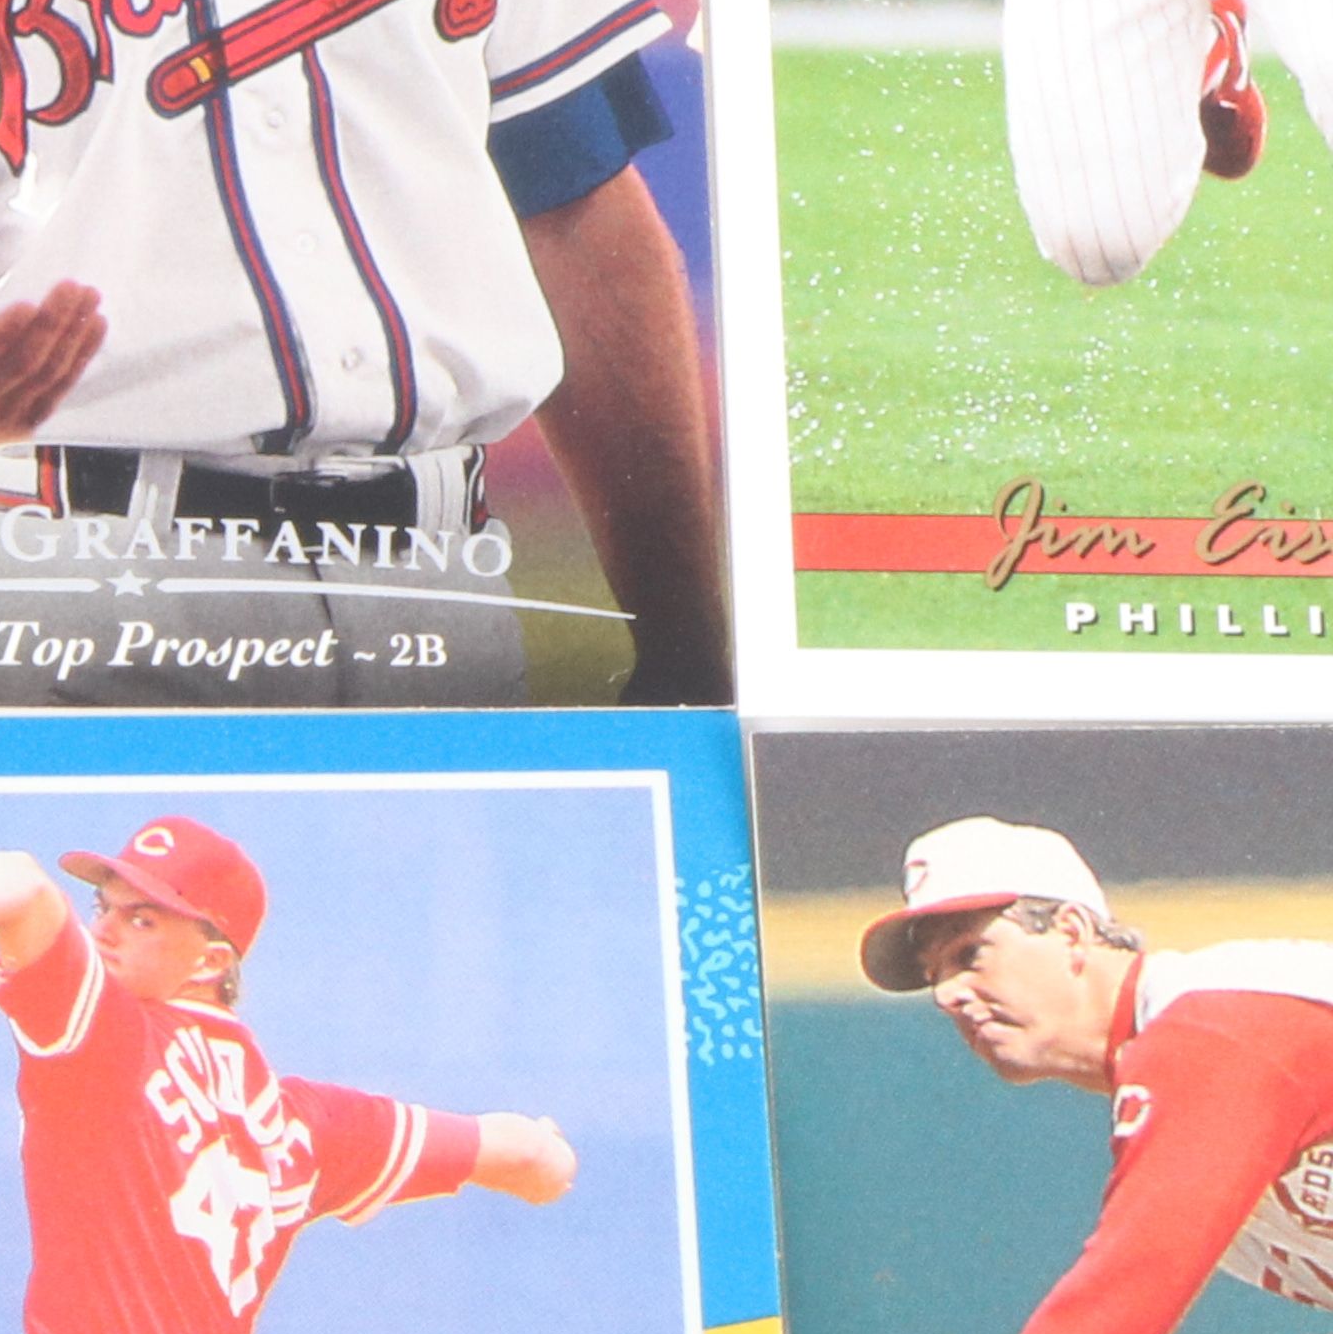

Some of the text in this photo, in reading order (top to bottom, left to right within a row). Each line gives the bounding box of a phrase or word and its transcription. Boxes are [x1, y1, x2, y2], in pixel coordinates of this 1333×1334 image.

[0, 505, 514, 579] GRAFFANINO
[986, 476, 1155, 591] Jim
[108, 622, 338, 681] Prospect
[389, 635, 447, 667] 2B
[1065, 602, 1326, 637] PHILLI
